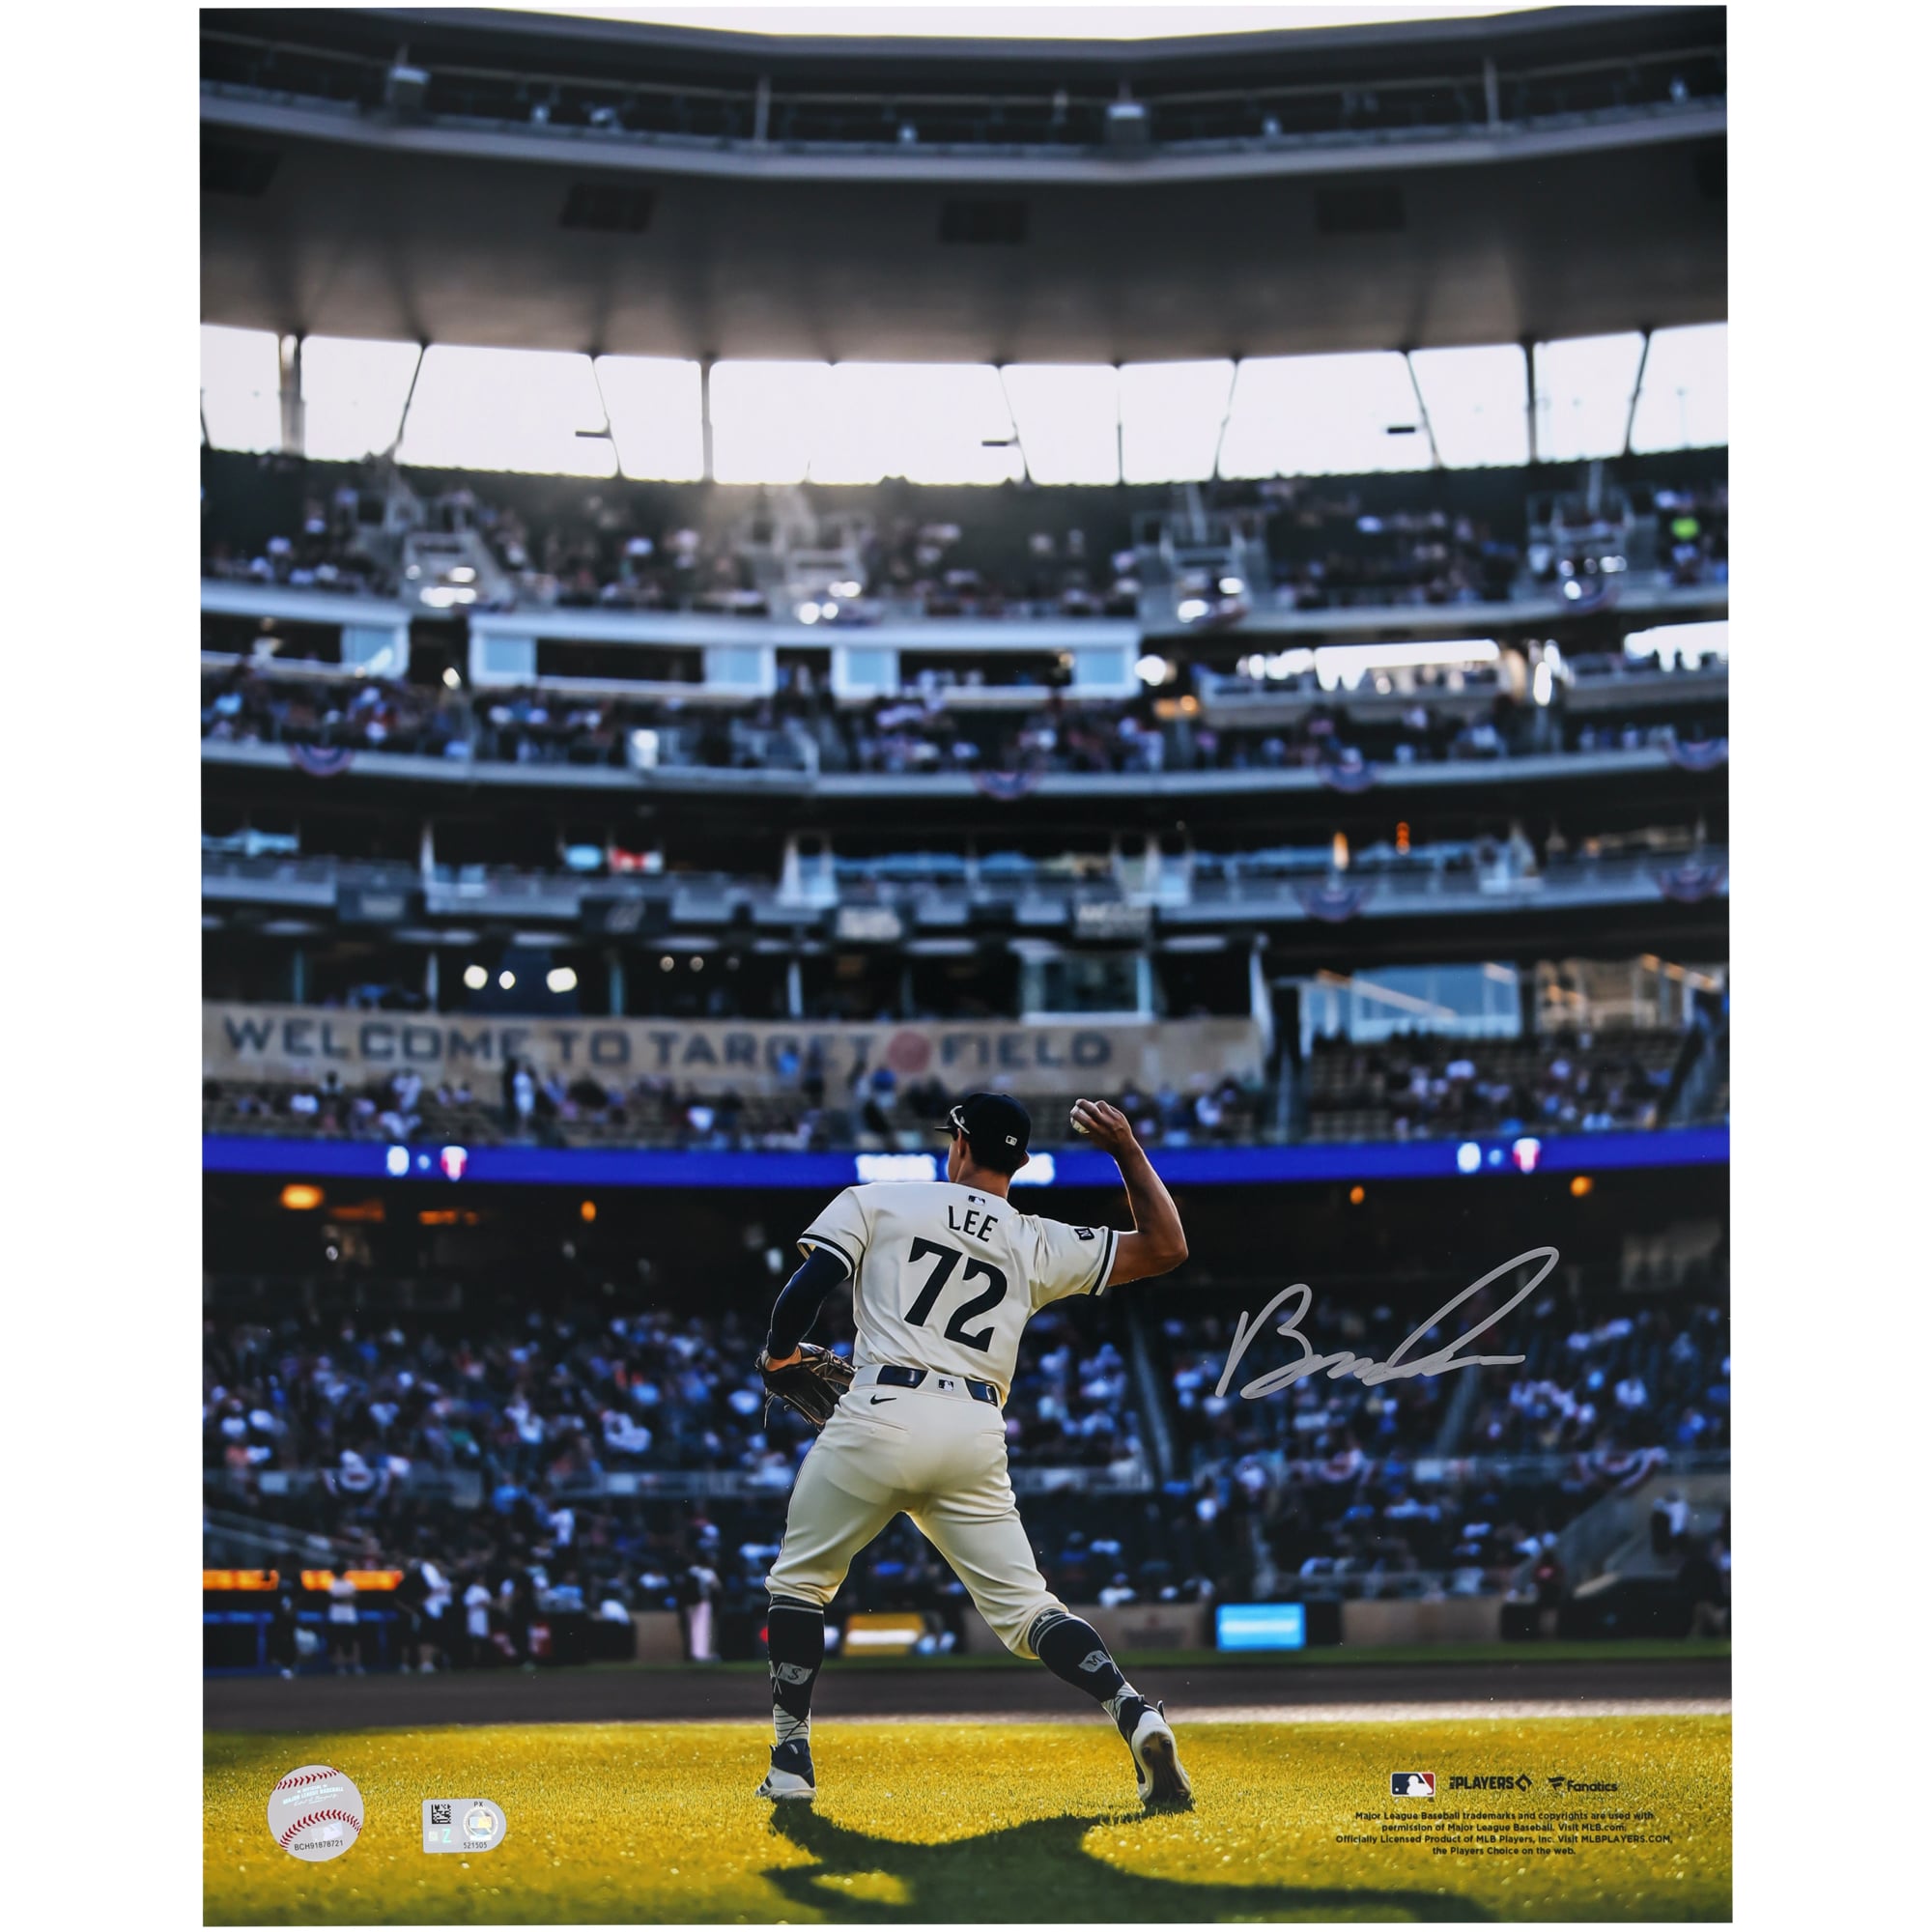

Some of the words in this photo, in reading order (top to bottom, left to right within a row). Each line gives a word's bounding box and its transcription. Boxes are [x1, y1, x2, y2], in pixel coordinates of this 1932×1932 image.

[223, 1014, 534, 1061] WELCOME
[554, 1029, 632, 1065] TO
[941, 1030, 1115, 1069] FIELD
[948, 1206, 999, 1242] LEE
[904, 1236, 1009, 1352] 72
[294, 1840, 344, 1852] BCH91878721
